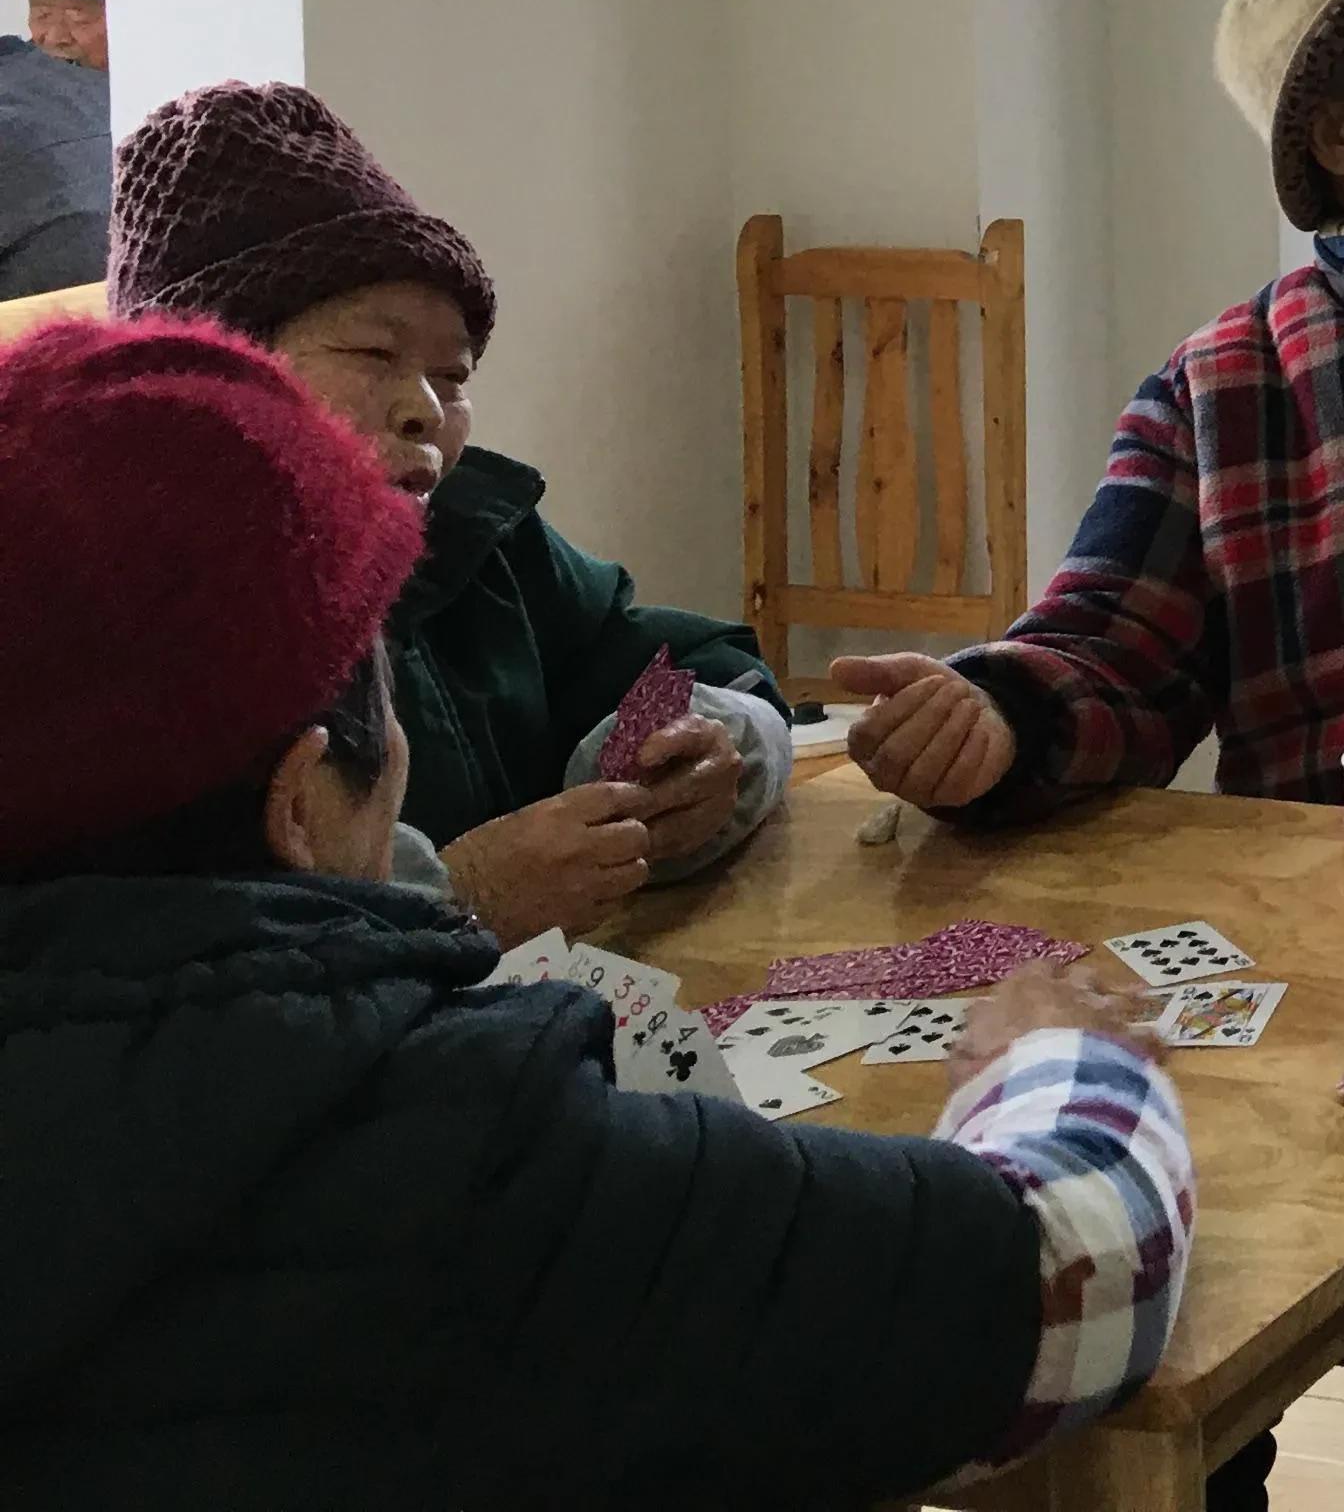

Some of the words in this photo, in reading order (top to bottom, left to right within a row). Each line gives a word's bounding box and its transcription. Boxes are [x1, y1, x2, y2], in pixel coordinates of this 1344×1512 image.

[586, 966, 605, 989] 9
[614, 974, 635, 1000] 3
[630, 993, 651, 1016] 8
